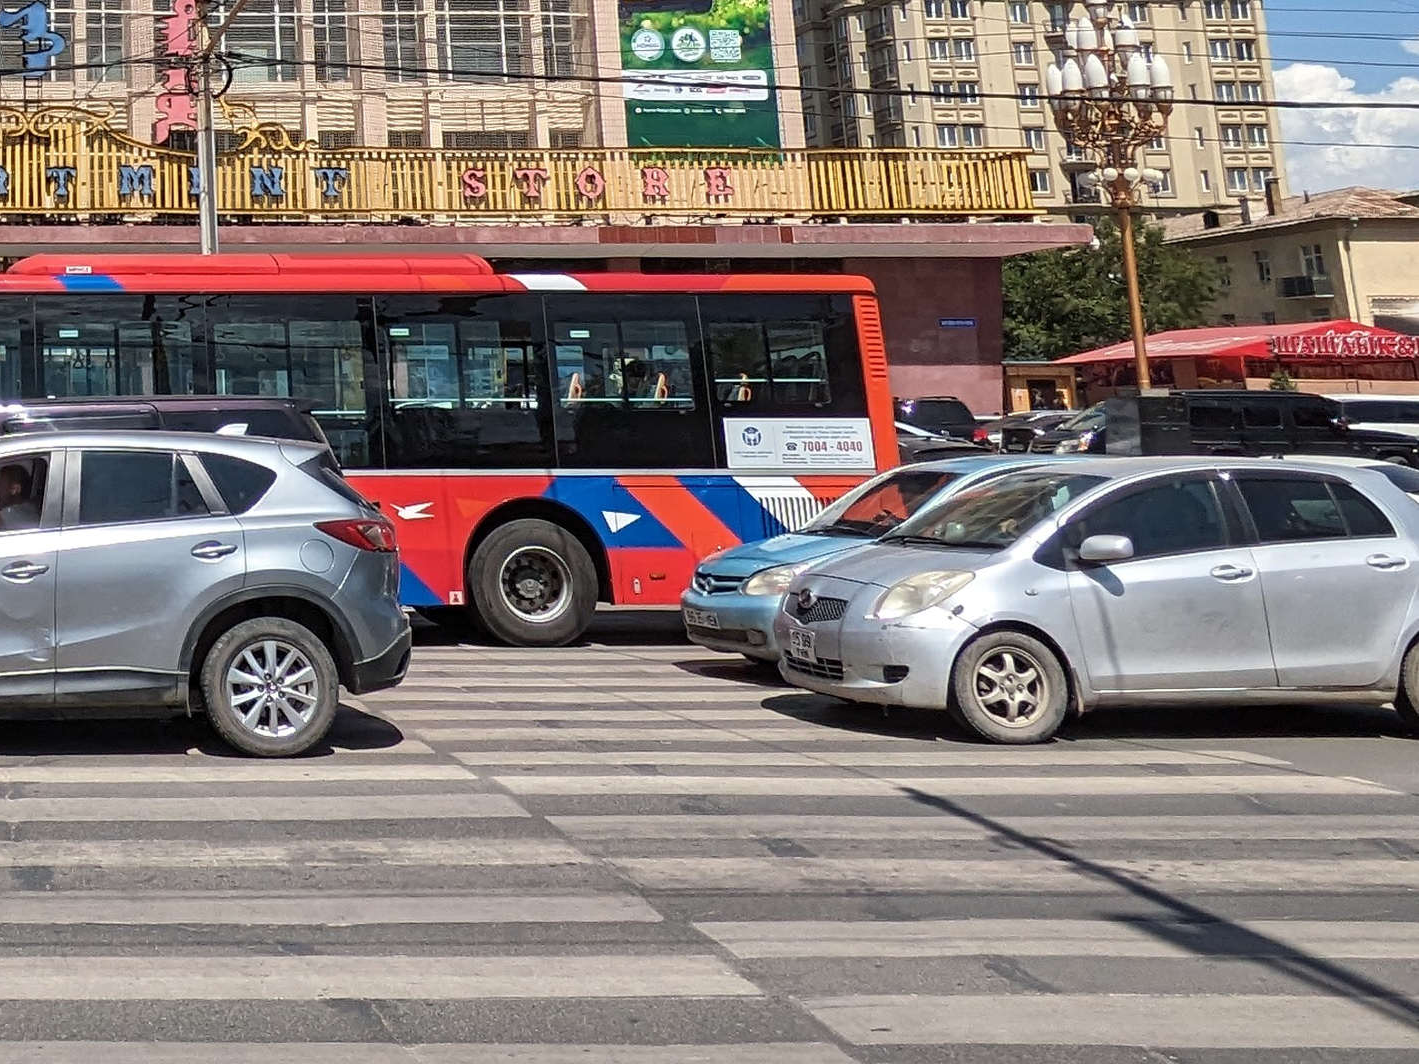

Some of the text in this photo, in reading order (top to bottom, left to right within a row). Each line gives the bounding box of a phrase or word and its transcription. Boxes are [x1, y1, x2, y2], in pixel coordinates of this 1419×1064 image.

[461, 166, 735, 199] STORE
[801, 441, 828, 452] 7004
[836, 441, 863, 452] 4040
